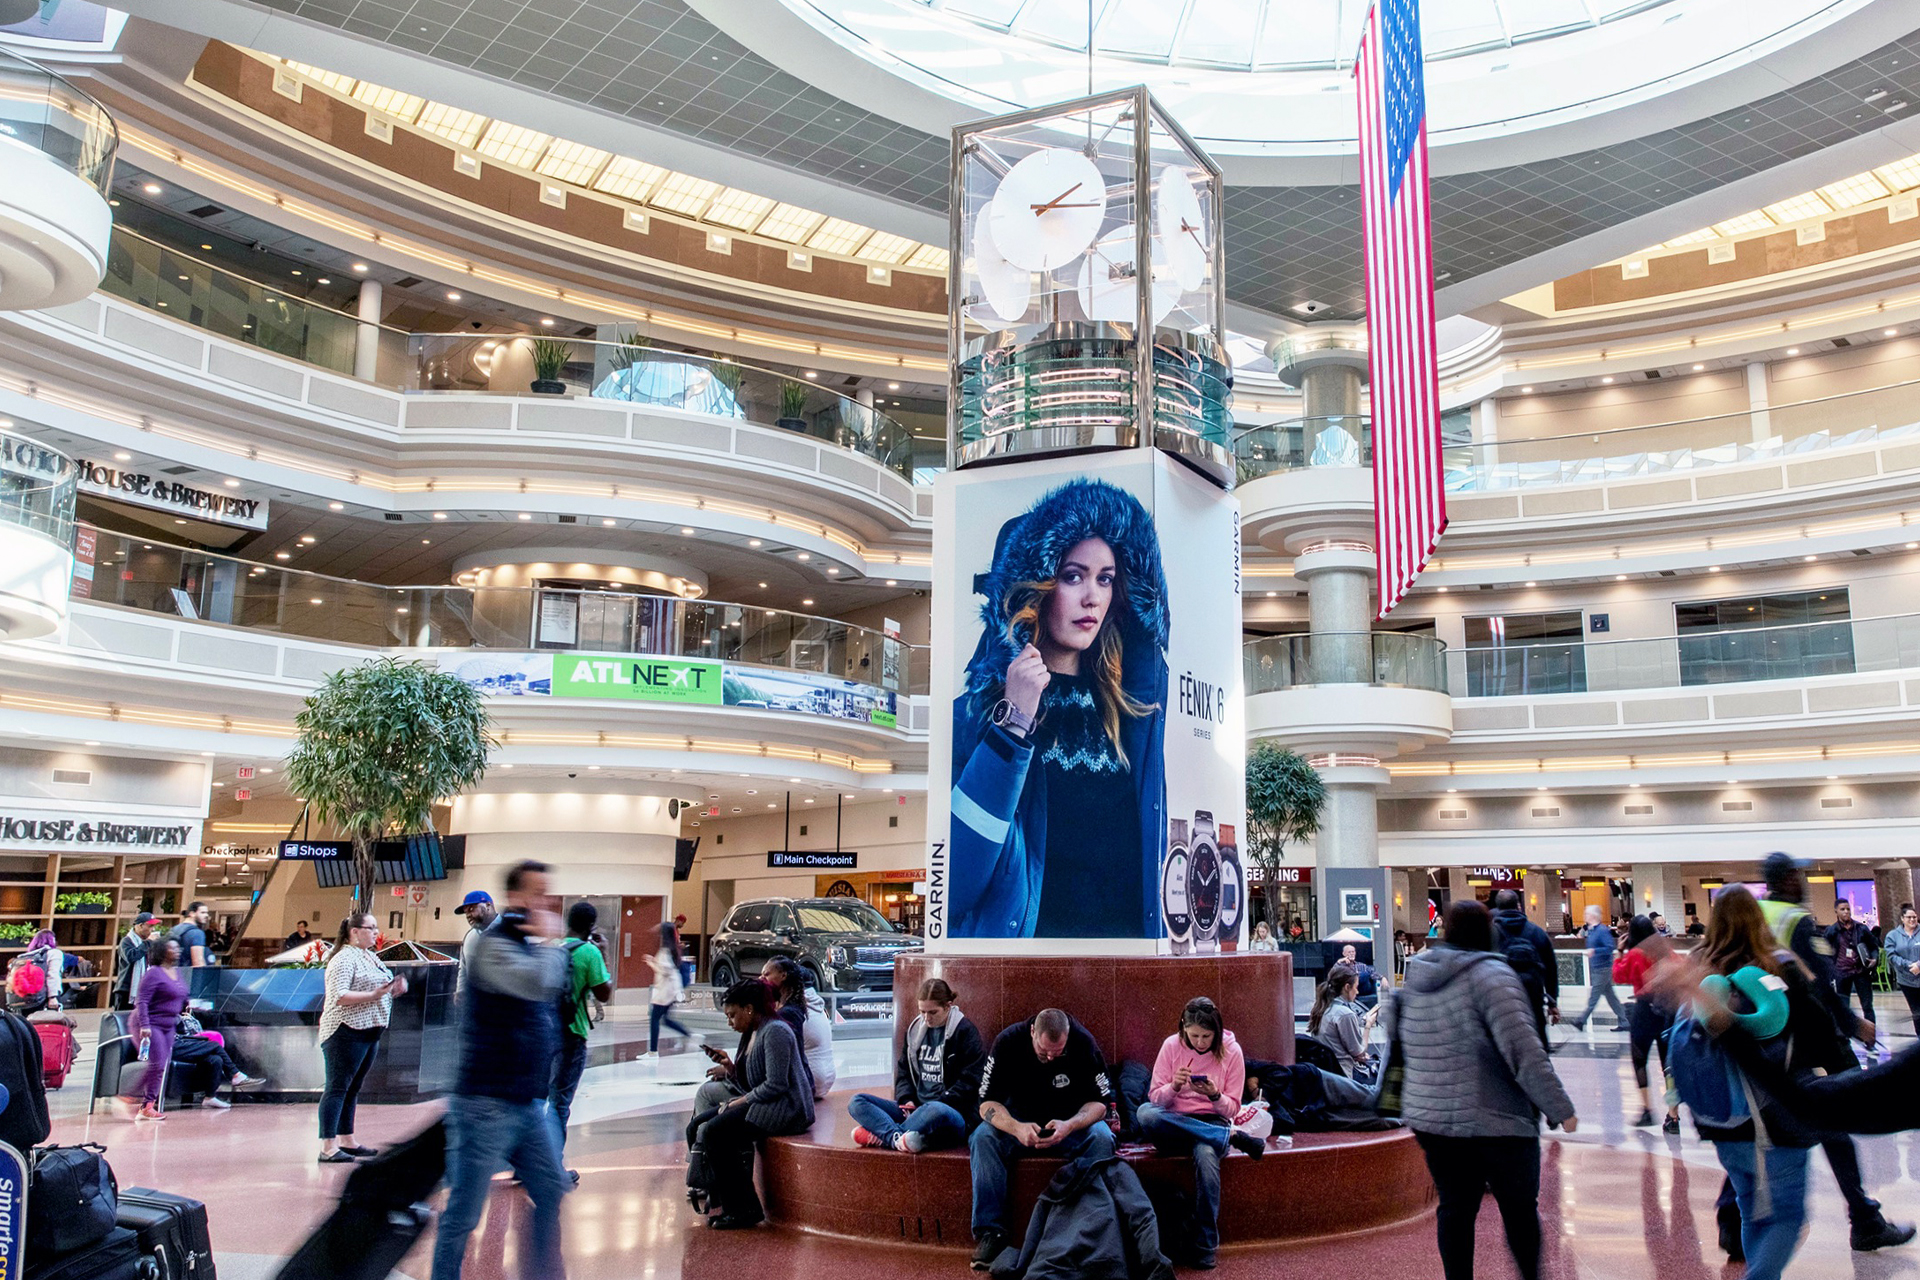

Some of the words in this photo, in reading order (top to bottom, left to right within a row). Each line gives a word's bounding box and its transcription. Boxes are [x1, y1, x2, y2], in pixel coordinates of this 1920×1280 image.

[171, 482, 259, 519] BREWERY
[1217, 687, 1224, 724] 6
[1193, 728, 1211, 740] SERIES
[239, 768, 253, 778] EXIT
[238, 790, 250, 799] EXIT
[76, 823, 96, 842] &
[98, 822, 193, 845] BREWERY
[300, 846, 337, 857] Shops
[784, 855, 804, 864] Main
[806, 855, 853, 865] Checkpoint
[929, 842, 945, 939] GARMIN
[851, 1004, 886, 1012] Produced
